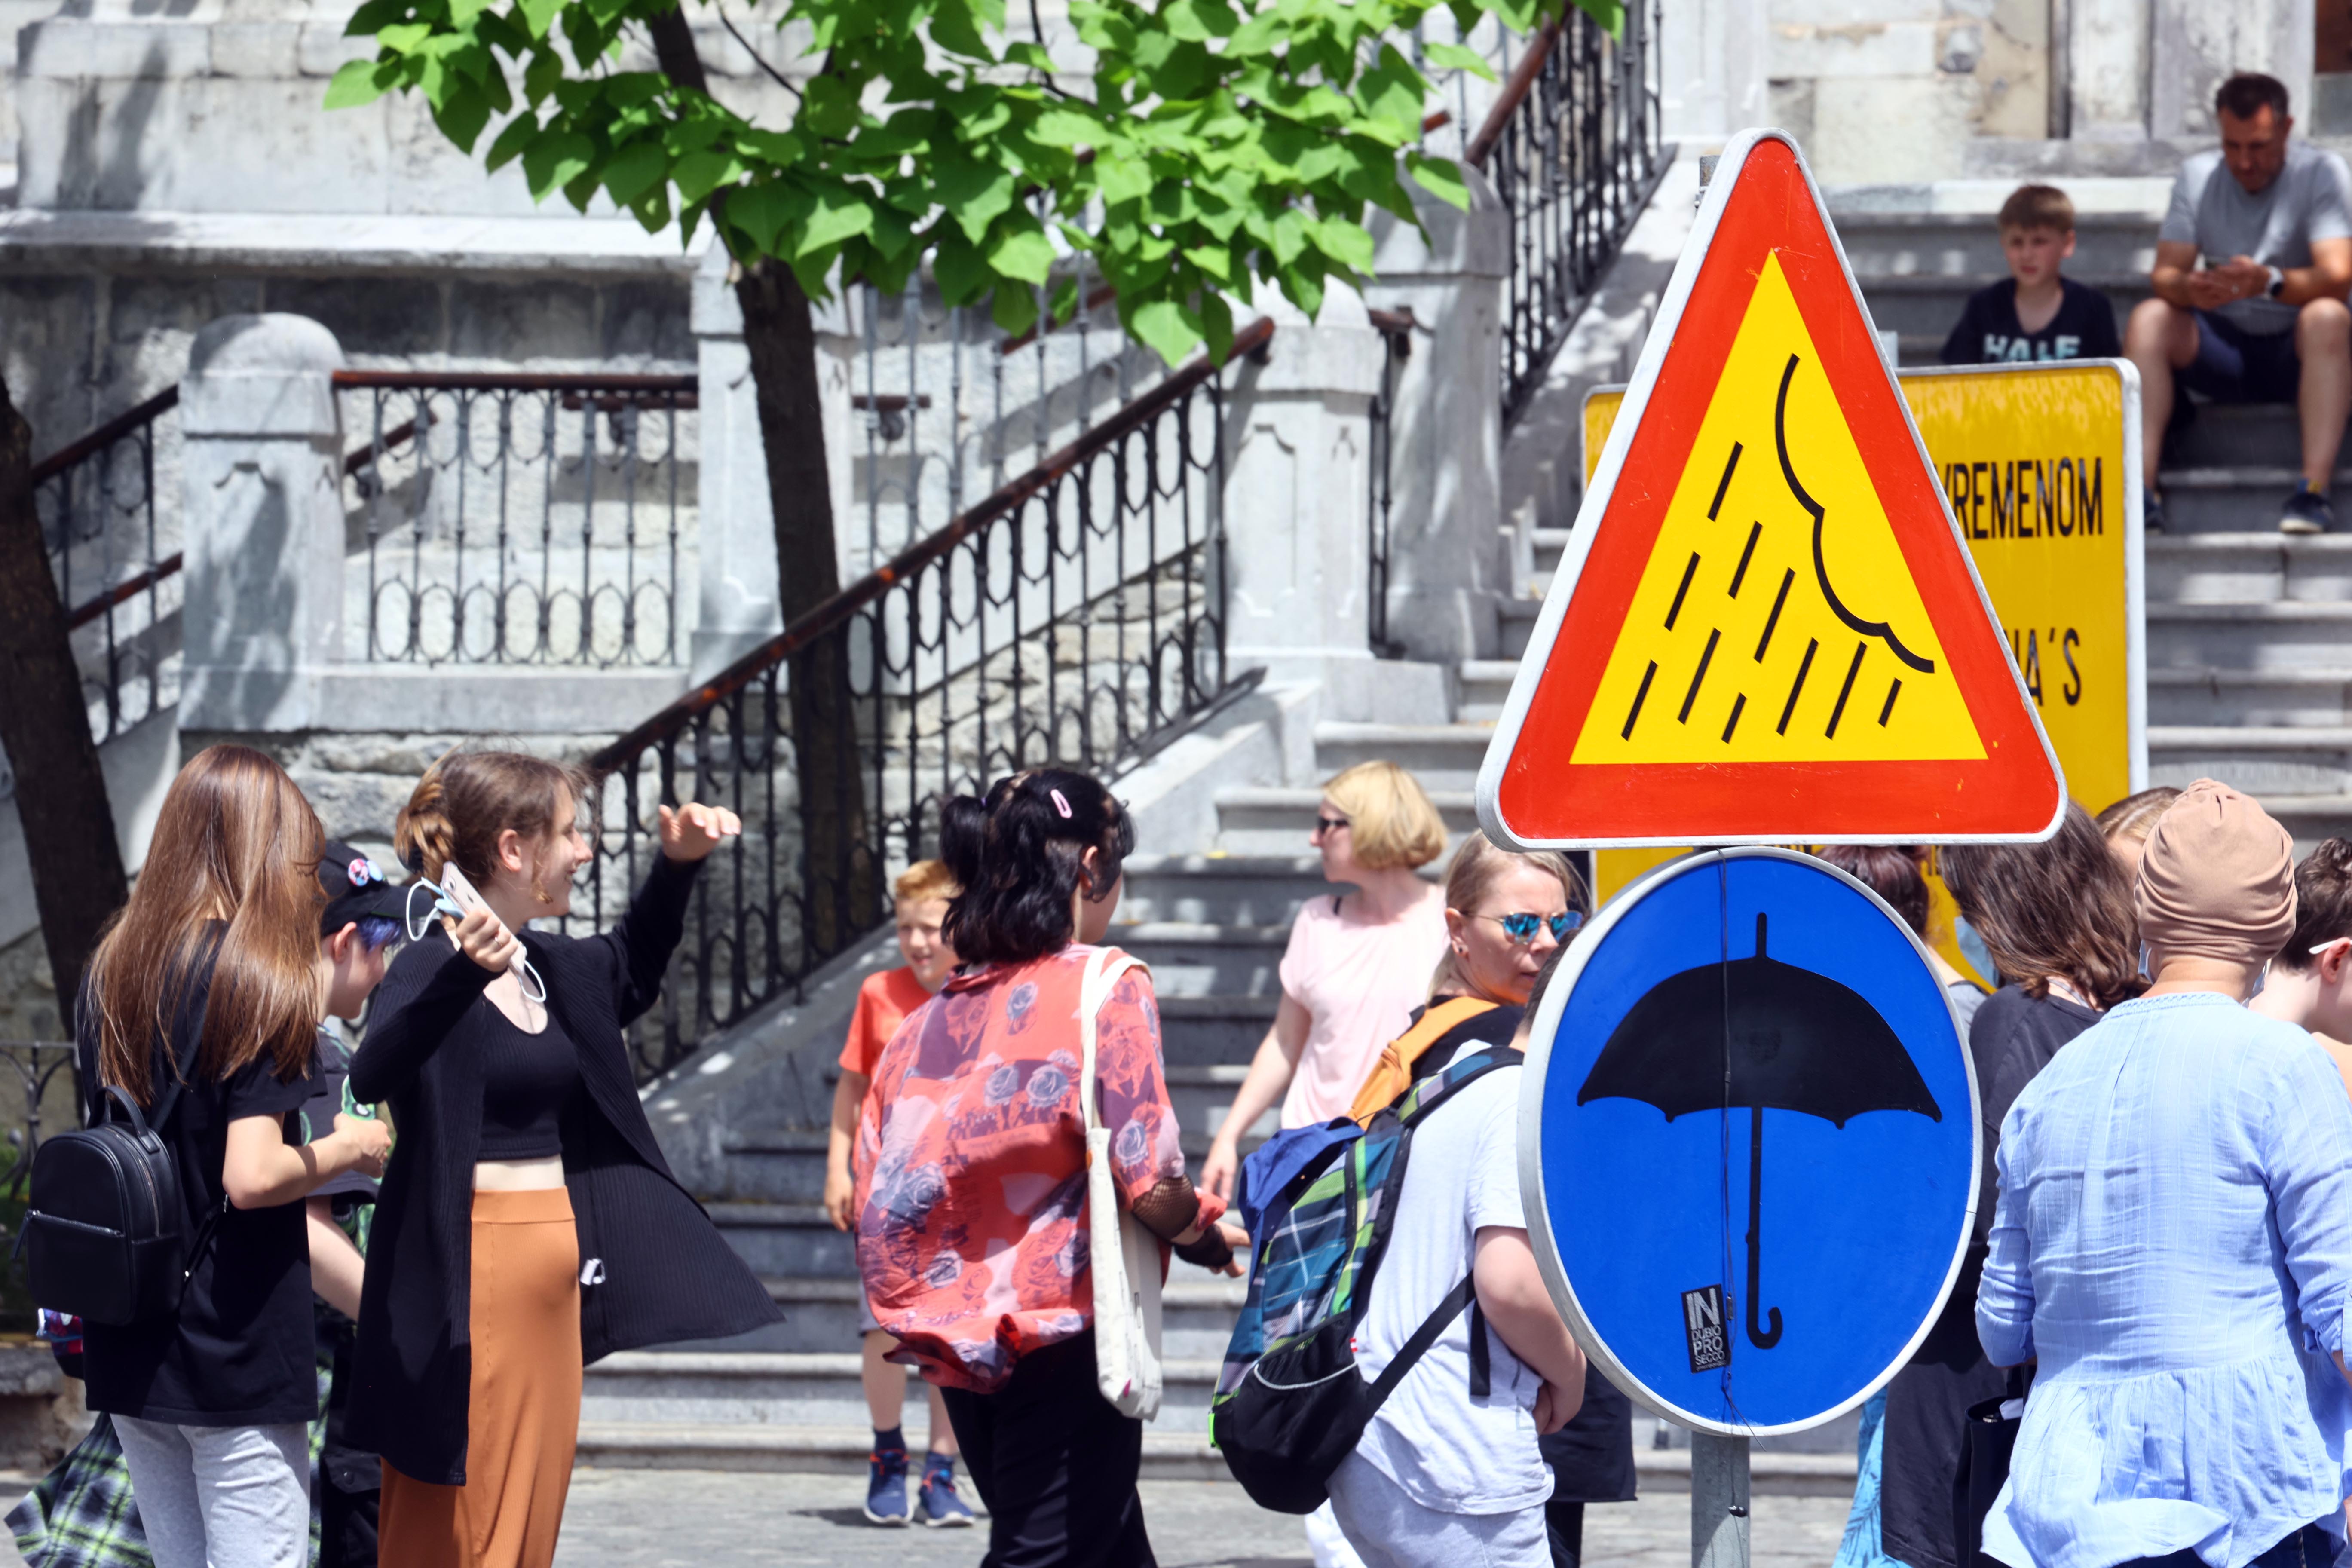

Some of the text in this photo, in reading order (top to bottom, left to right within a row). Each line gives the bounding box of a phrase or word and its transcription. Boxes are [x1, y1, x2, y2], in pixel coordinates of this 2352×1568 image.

[1686, 1288, 1720, 1330] IN
[1691, 1325, 1721, 1341] DUBIO
[1693, 1336, 1723, 1355] PRO
[1696, 1350, 1725, 1365] SECCO
